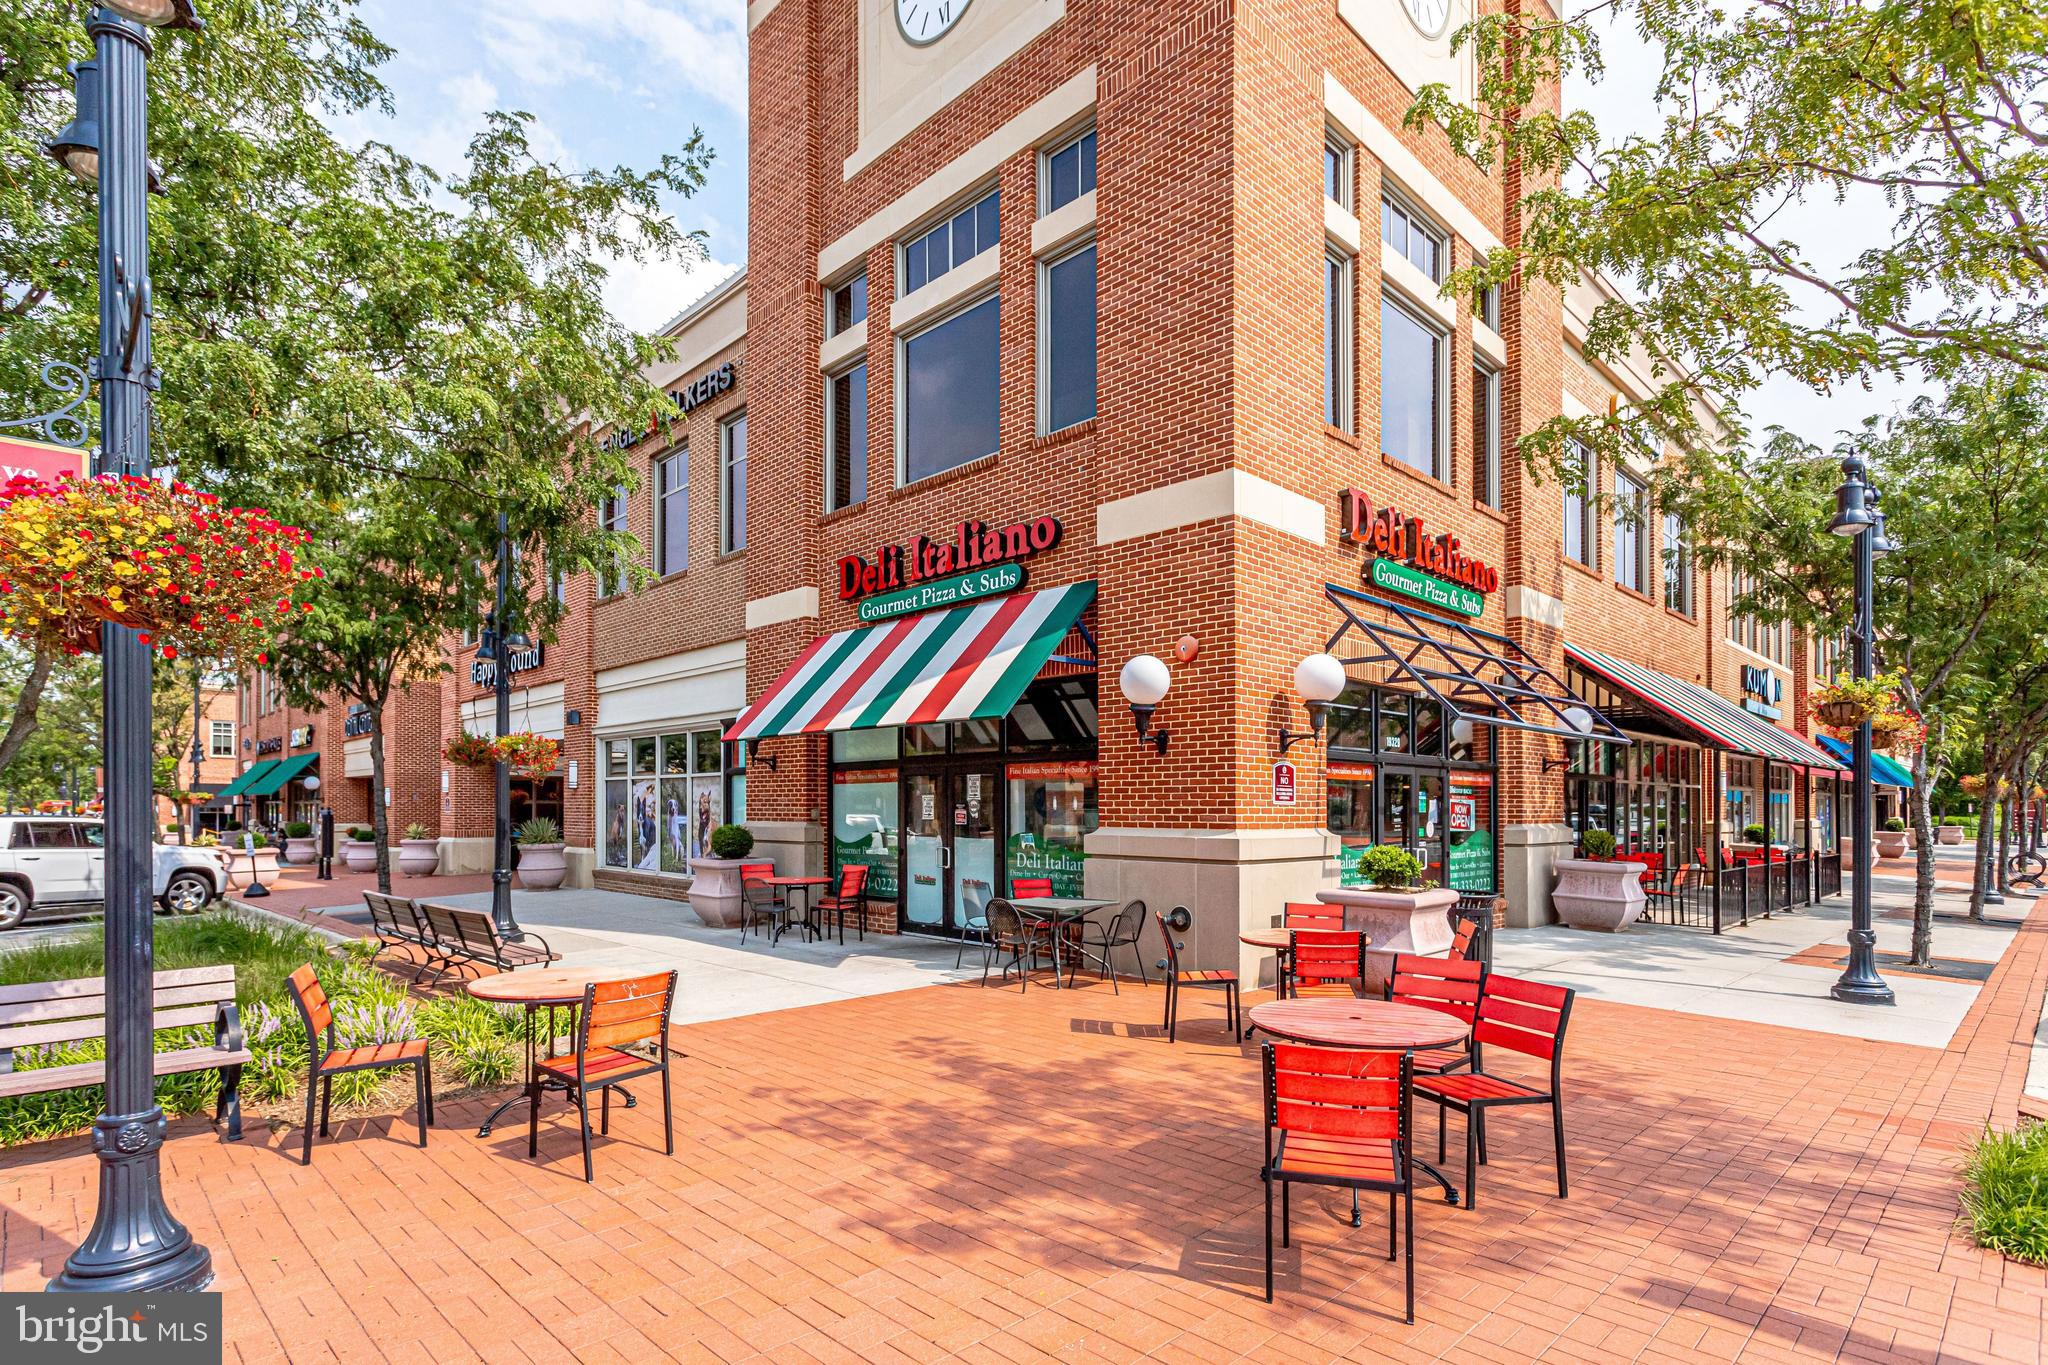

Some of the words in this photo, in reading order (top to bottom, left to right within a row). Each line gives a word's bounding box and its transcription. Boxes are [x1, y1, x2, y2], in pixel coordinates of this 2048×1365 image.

[1348, 487, 1407, 560] Deli
[1414, 516, 1498, 593] Italiano
[837, 544, 900, 600] Deli
[909, 516, 1056, 580] Italiano
[861, 592, 918, 619] Gourmet
[921, 586, 956, 606] Pizza
[960, 579, 975, 596] &
[980, 570, 1016, 592] Subs
[1375, 562, 1422, 594] Gourmet
[1424, 579, 1448, 605] Pizza
[1450, 590, 1459, 610] &
[1462, 593, 1481, 616] Subs
[510, 640, 540, 673] ound
[1280, 777, 1289, 785] NO
[1451, 813, 1470, 828] OPEN
[1454, 804, 1468, 814] NOW
[1016, 852, 1041, 868] Deli
